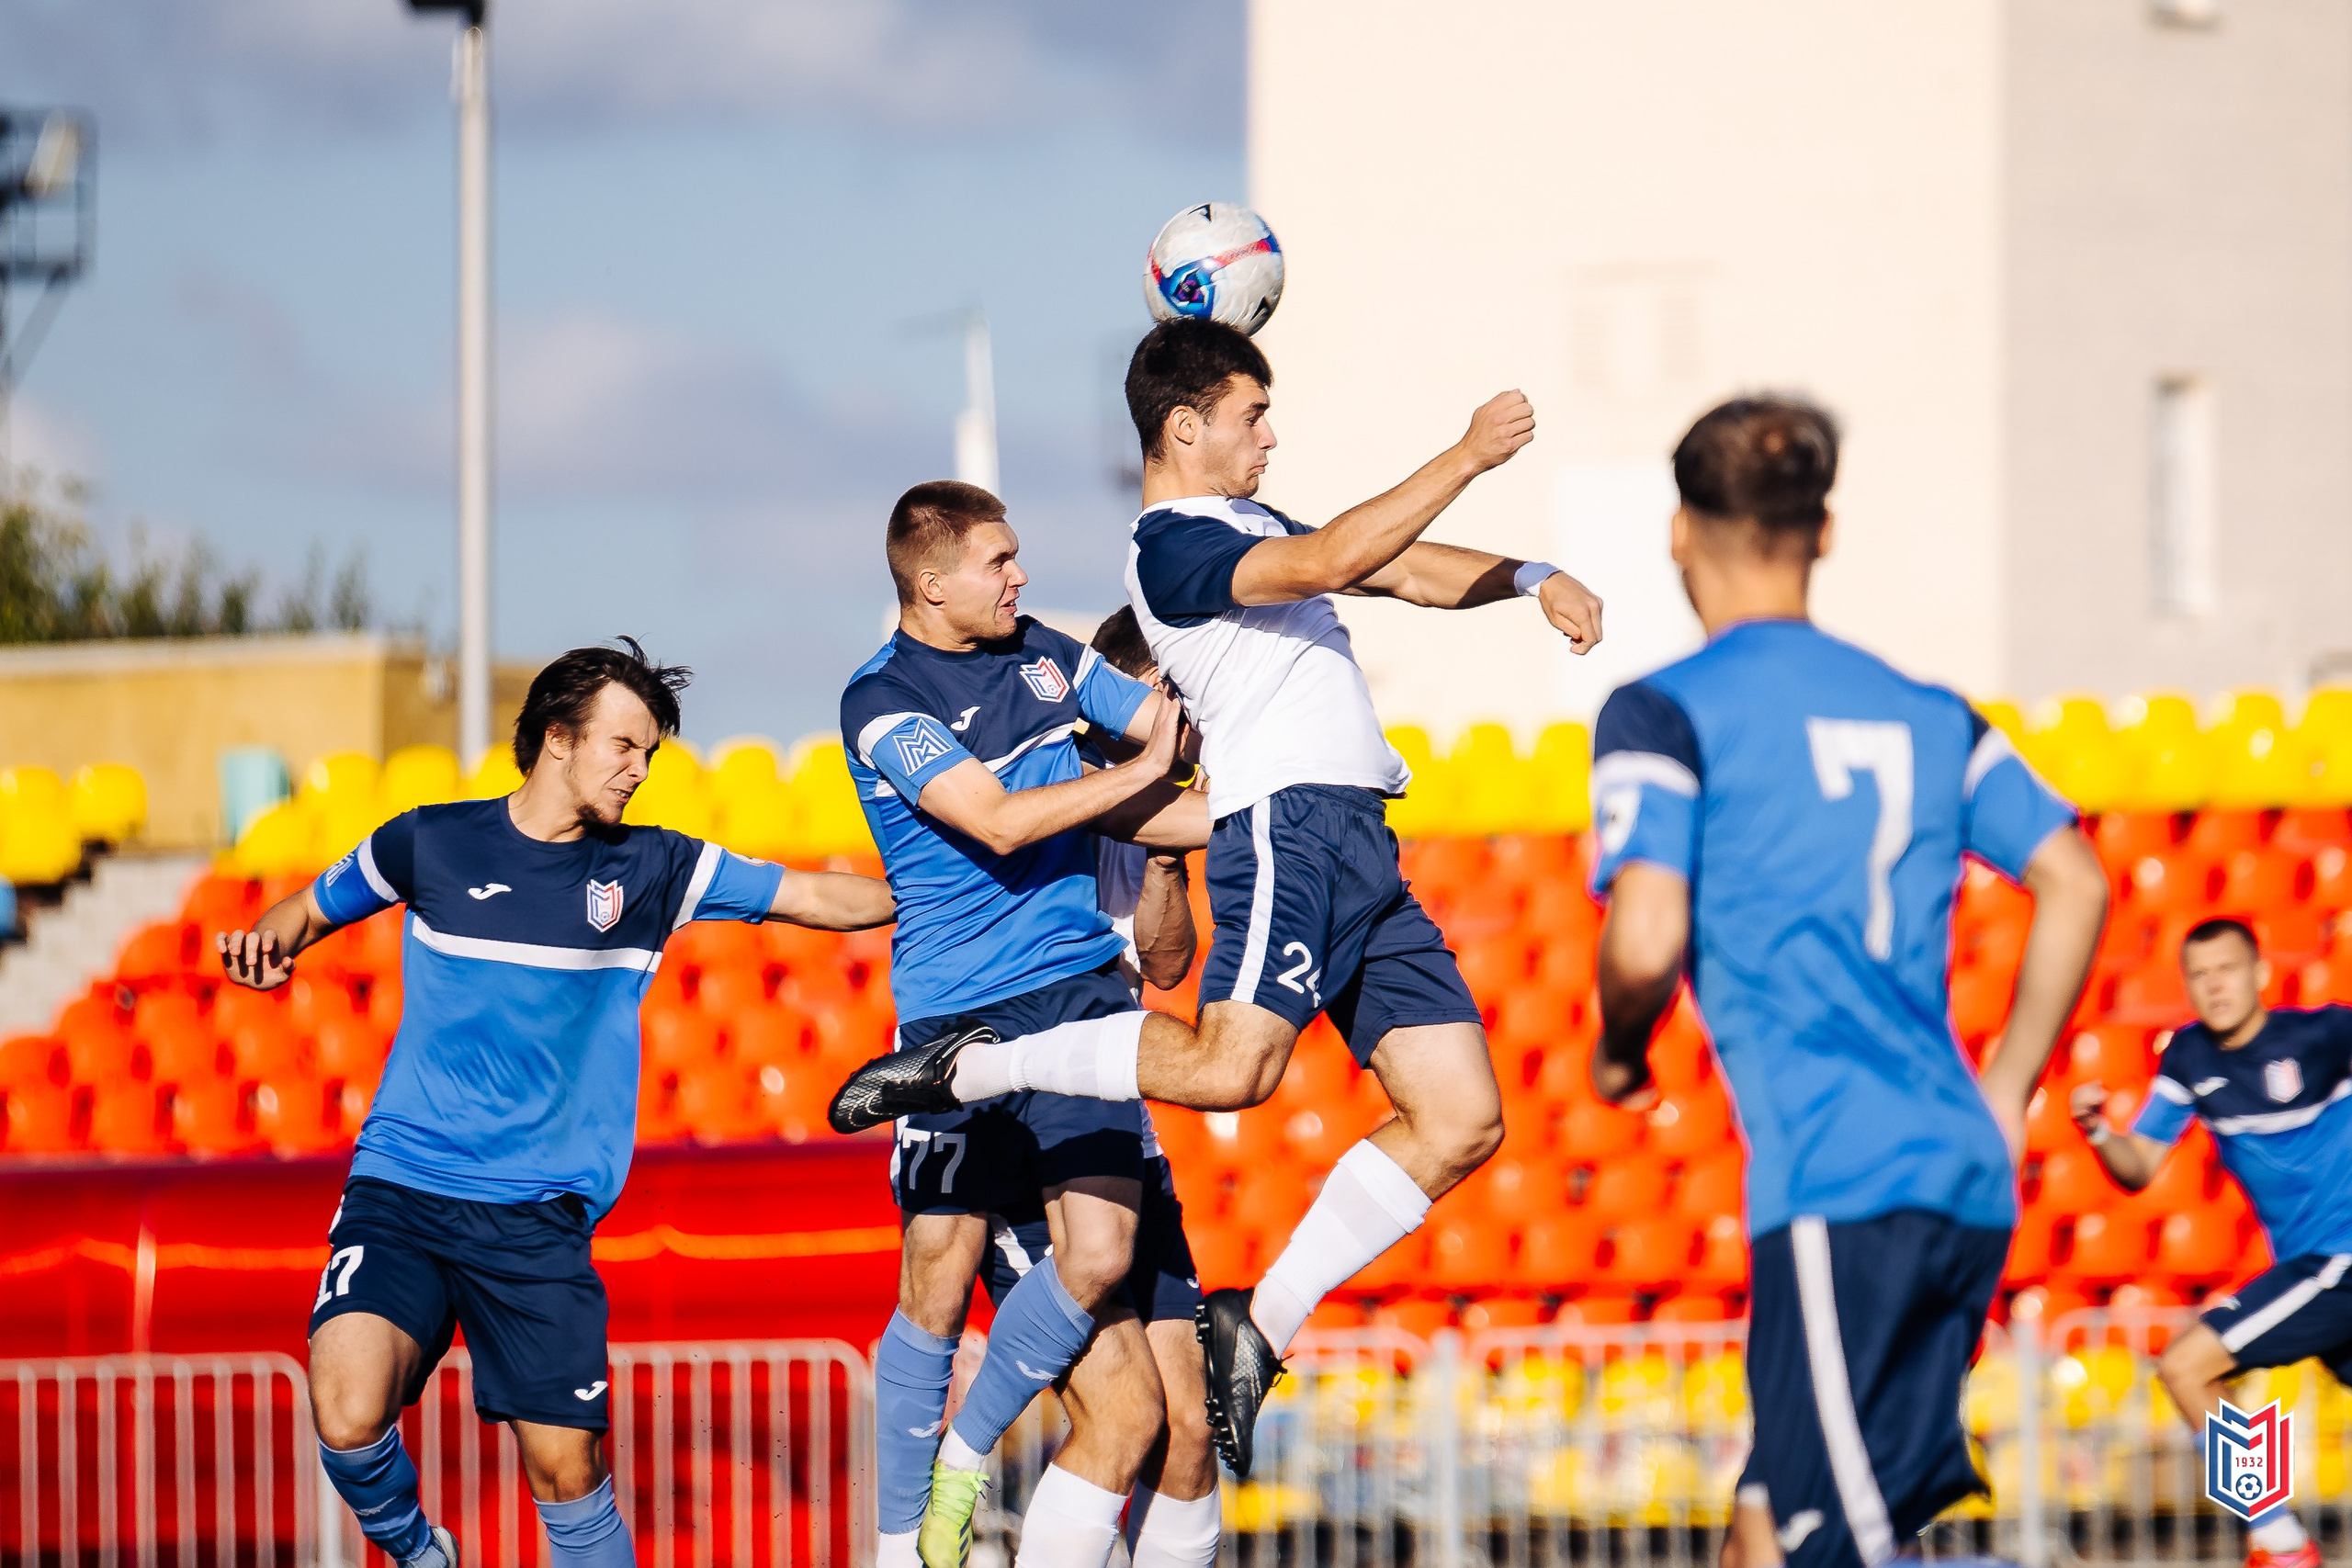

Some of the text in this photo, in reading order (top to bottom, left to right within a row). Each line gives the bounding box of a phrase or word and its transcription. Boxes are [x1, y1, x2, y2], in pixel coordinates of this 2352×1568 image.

[1805, 716, 1914, 963] 7
[902, 1128, 967, 1193] 77
[313, 1245, 365, 1314] 17
